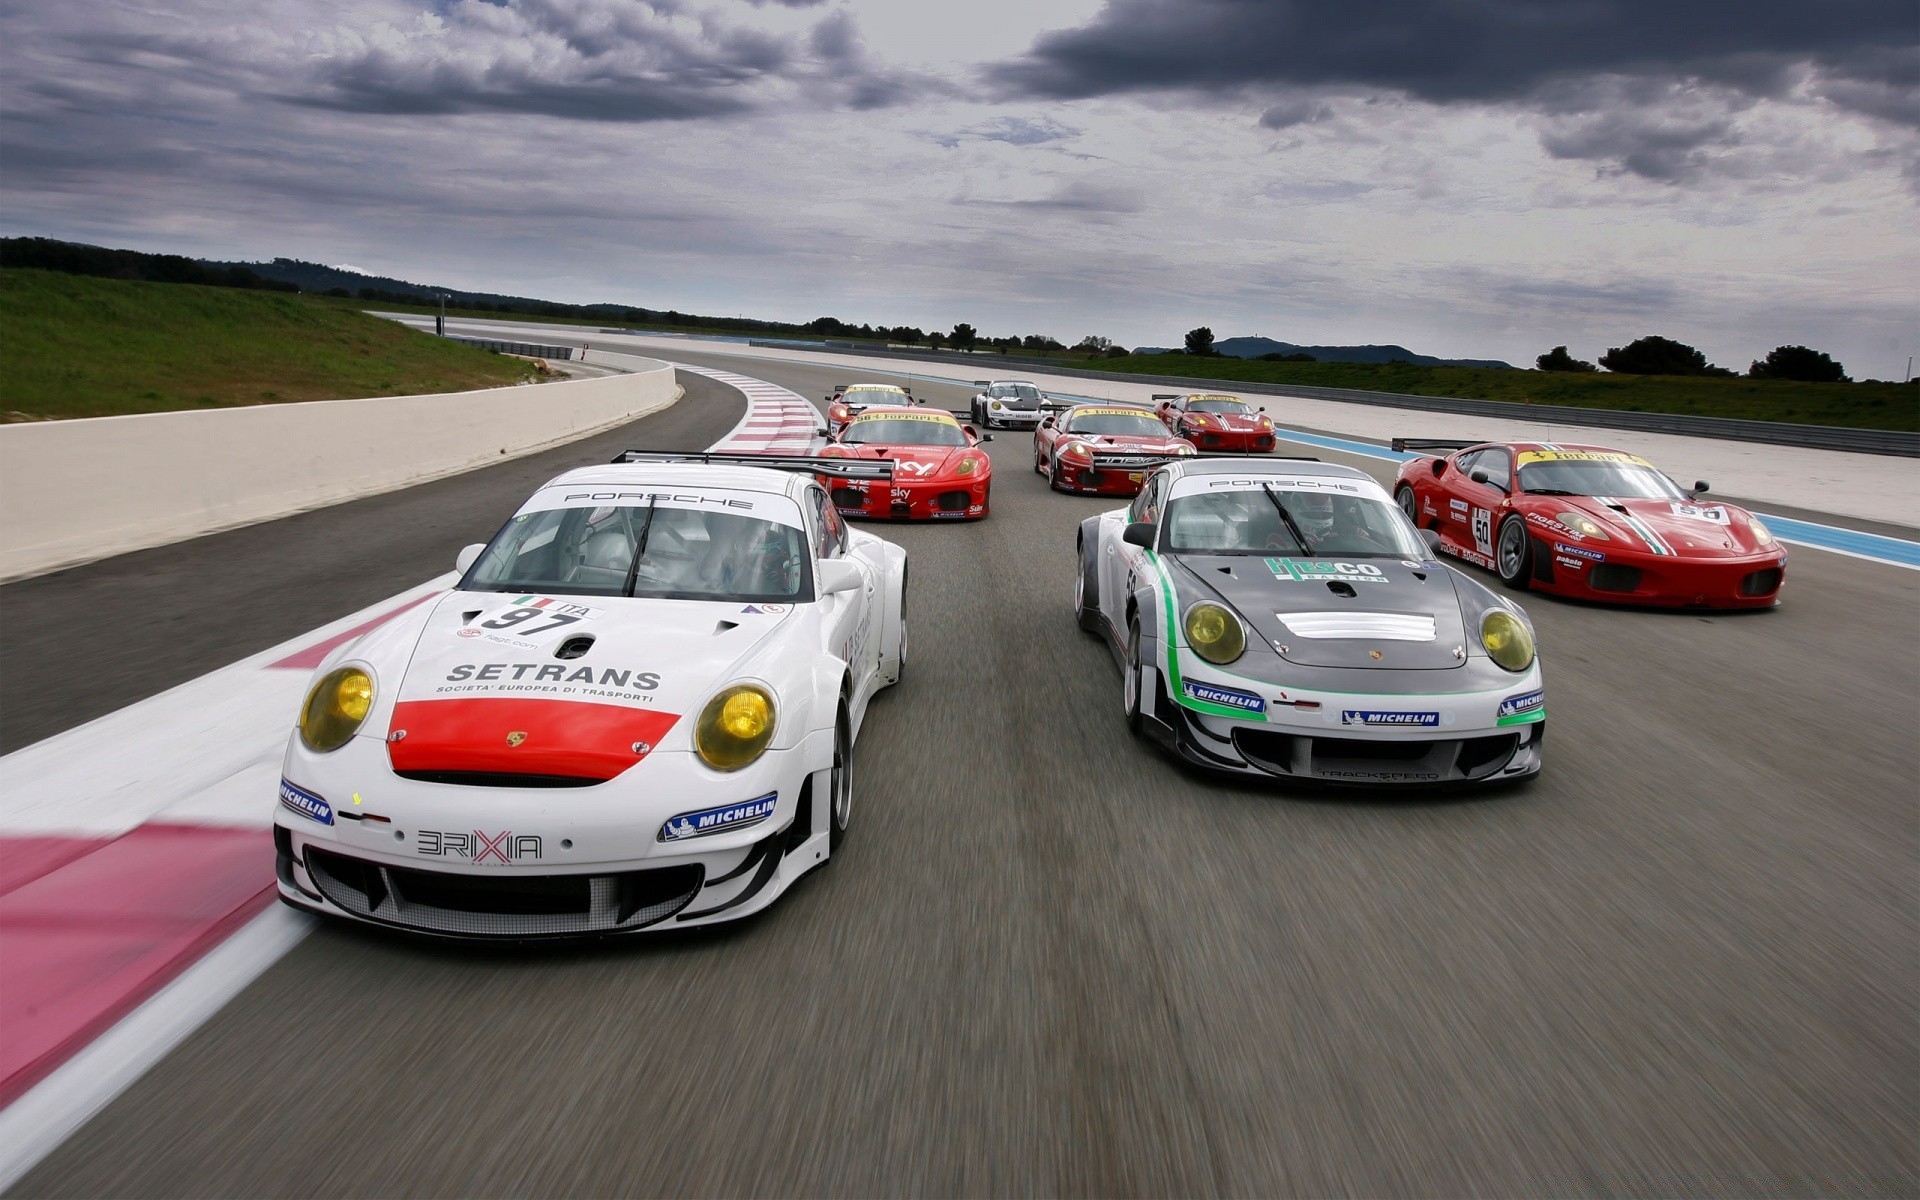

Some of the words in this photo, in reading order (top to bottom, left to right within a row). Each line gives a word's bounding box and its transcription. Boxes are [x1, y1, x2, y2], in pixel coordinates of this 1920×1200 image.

[1553, 451, 1628, 463] Ferrari
[894, 457, 935, 476] ky
[890, 486, 911, 499] sky
[1209, 479, 1359, 492] PORSCHE
[564, 492, 754, 510] PORSCHE
[1475, 519, 1489, 545] 50
[1555, 555, 1583, 567] pakelo
[1564, 546, 1603, 559] MICHELIN
[1263, 557, 1383, 581] HESCO
[556, 603, 591, 617] ITA
[481, 607, 582, 636] 97
[446, 663, 661, 691] SETRANS
[500, 684, 558, 693] EUROPEA
[563, 686, 576, 694] DI
[582, 688, 654, 703] TRASPORTI
[1197, 688, 1261, 709] MICHELIN
[1367, 713, 1436, 723] MICHELIN
[1320, 770, 1440, 779] TRACKSPEED
[279, 784, 330, 818] MICHELIN
[699, 799, 775, 829] MICHELIN
